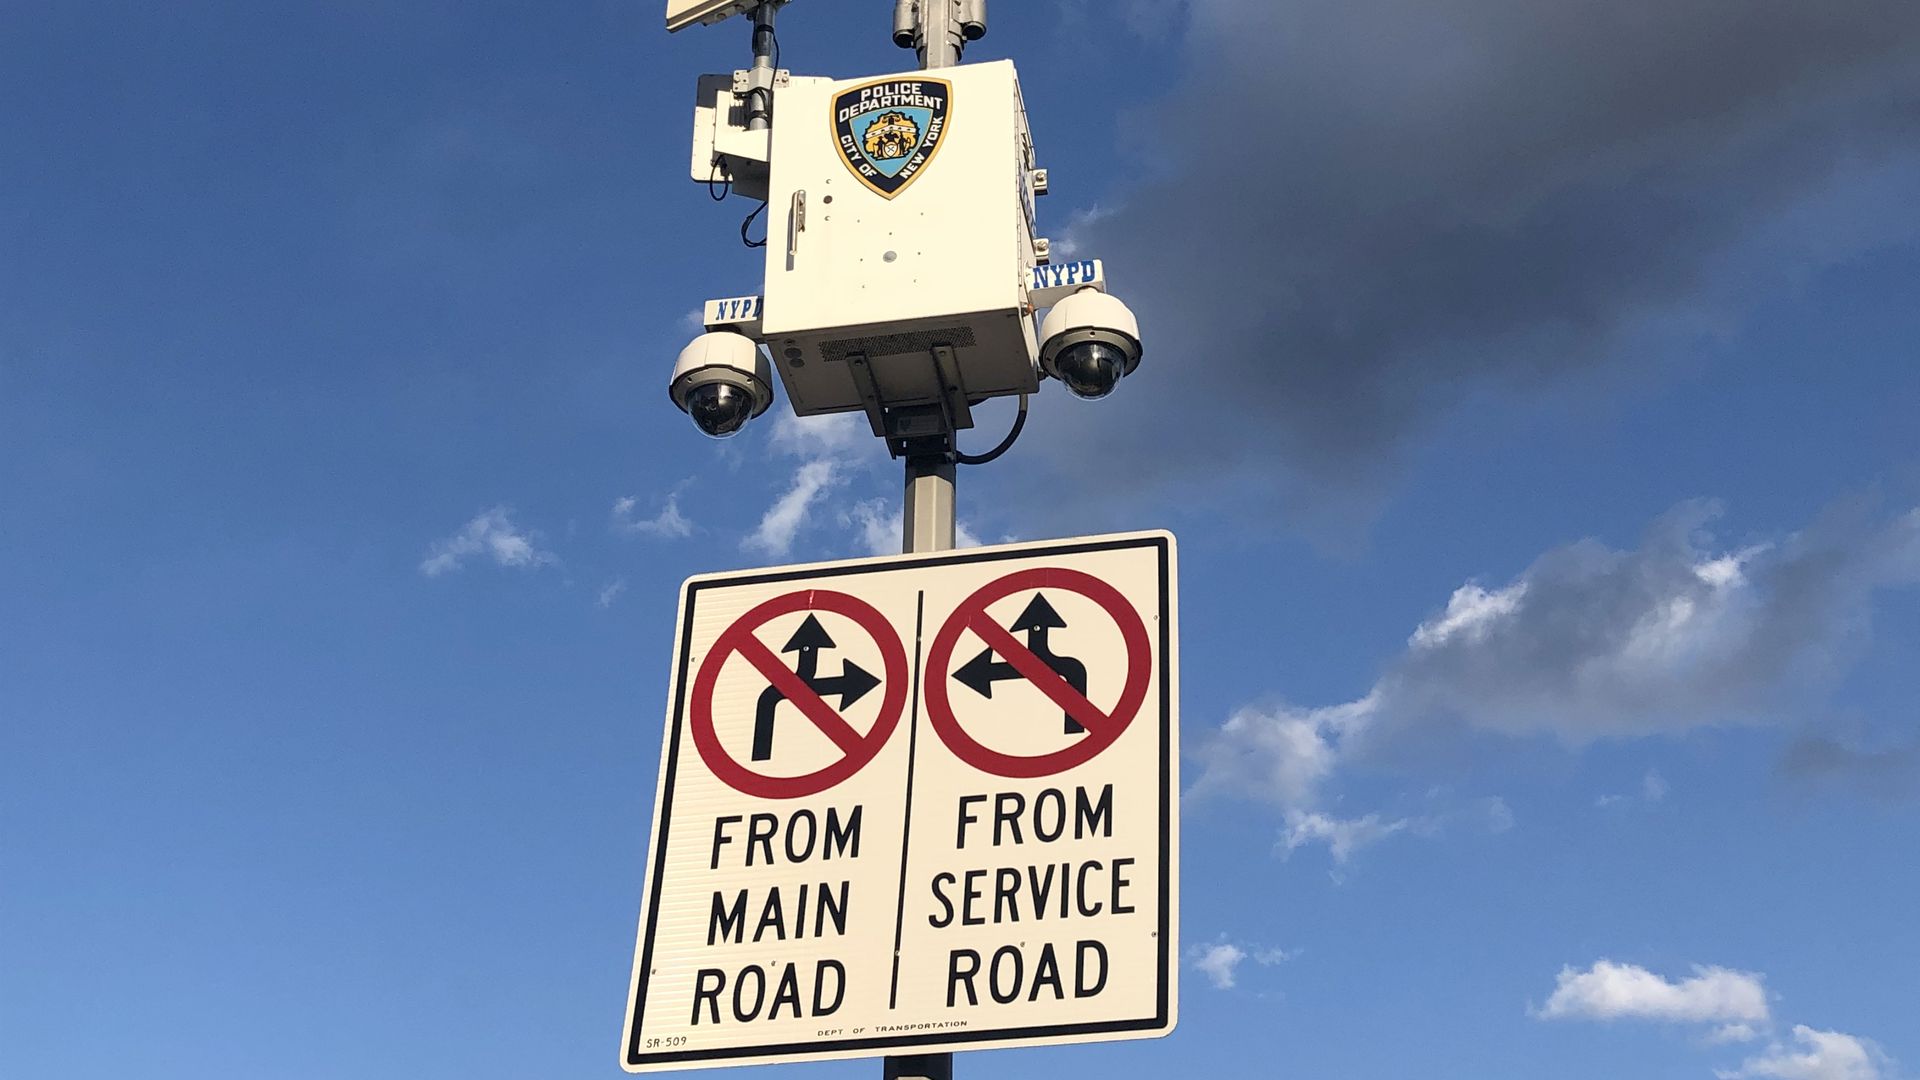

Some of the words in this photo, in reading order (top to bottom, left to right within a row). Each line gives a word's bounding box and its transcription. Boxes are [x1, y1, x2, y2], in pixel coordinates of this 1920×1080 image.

[840, 94, 943, 123] DEPARTMENT
[861, 83, 922, 101] POLICE
[841, 134, 862, 161] CITY
[859, 163, 878, 177] OF
[899, 152, 925, 179] NEW
[922, 116, 944, 148] YORK
[1033, 260, 1095, 289] NYPD
[711, 805, 862, 869] FROM
[957, 784, 1112, 849] FROM
[707, 881, 849, 945] MAIN
[929, 858, 1134, 928] SERVICE
[691, 960, 845, 1025] ROAD
[947, 940, 1108, 1007] ROAD
[646, 1036, 687, 1048] SR-509
[817, 1028, 843, 1036] DEPT
[875, 1020, 968, 1032] TRANSPORTATION
